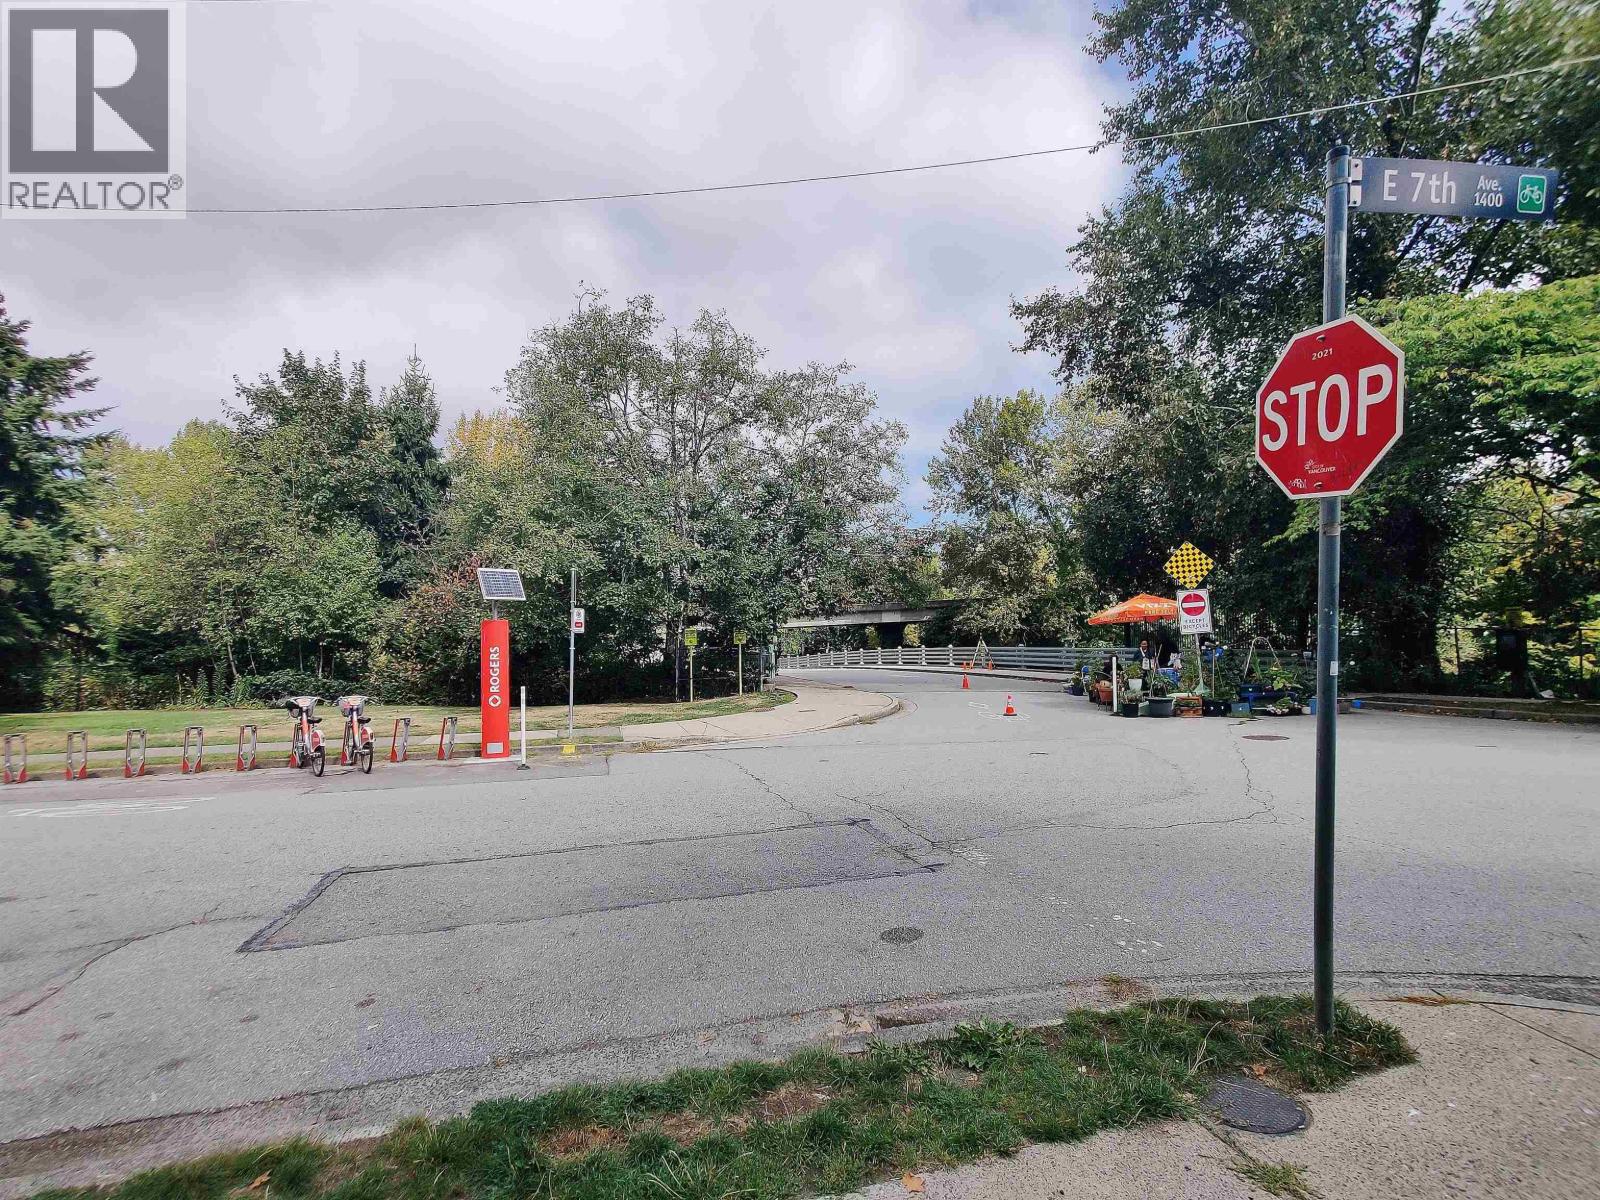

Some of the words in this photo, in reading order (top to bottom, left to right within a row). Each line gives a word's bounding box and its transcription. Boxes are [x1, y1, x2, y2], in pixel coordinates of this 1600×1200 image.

[1383, 169, 1399, 201] E
[1410, 171, 1457, 204] 7th
[1477, 175, 1502, 191] Ave.
[1473, 191, 1503, 208] 1400
[1311, 347, 1333, 361] 2021
[1262, 363, 1393, 452] STOP
[489, 646, 500, 693] ROGERS
